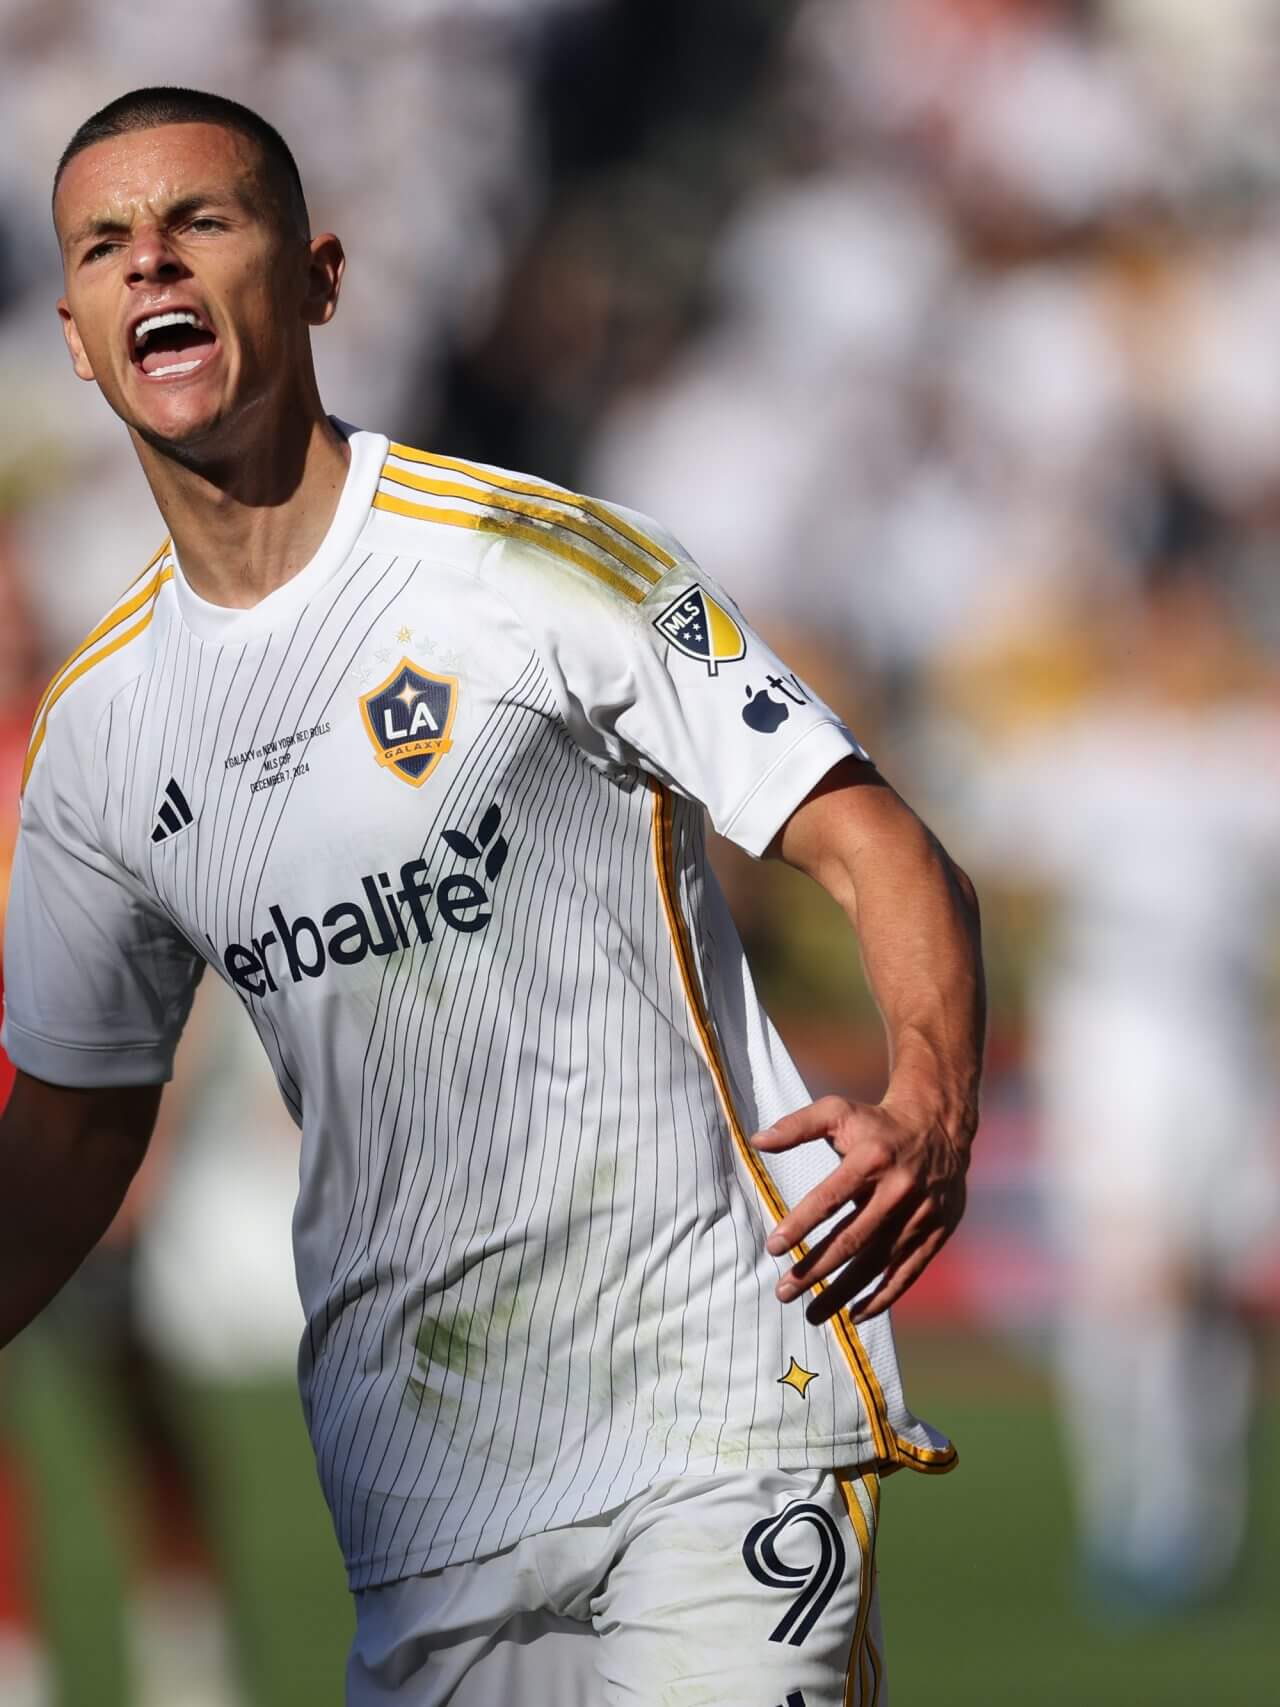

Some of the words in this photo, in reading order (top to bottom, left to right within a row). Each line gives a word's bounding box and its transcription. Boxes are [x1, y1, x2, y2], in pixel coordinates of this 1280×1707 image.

[664, 601, 700, 636] MLS
[383, 702, 439, 741] LA
[229, 749, 255, 768] GALAXY
[262, 743, 278, 755] NEW
[278, 735, 296, 750] YORK
[296, 730, 309, 743] RED
[309, 722, 331, 738] BULLS
[263, 758, 278, 771] MLS
[278, 753, 291, 766] CUP
[384, 740, 443, 759] GALAXY
[250, 772, 285, 794] DECEMBER
[292, 762, 310, 777] 2024
[206, 858, 492, 999] erbalife
[742, 1498, 846, 1647] 9
